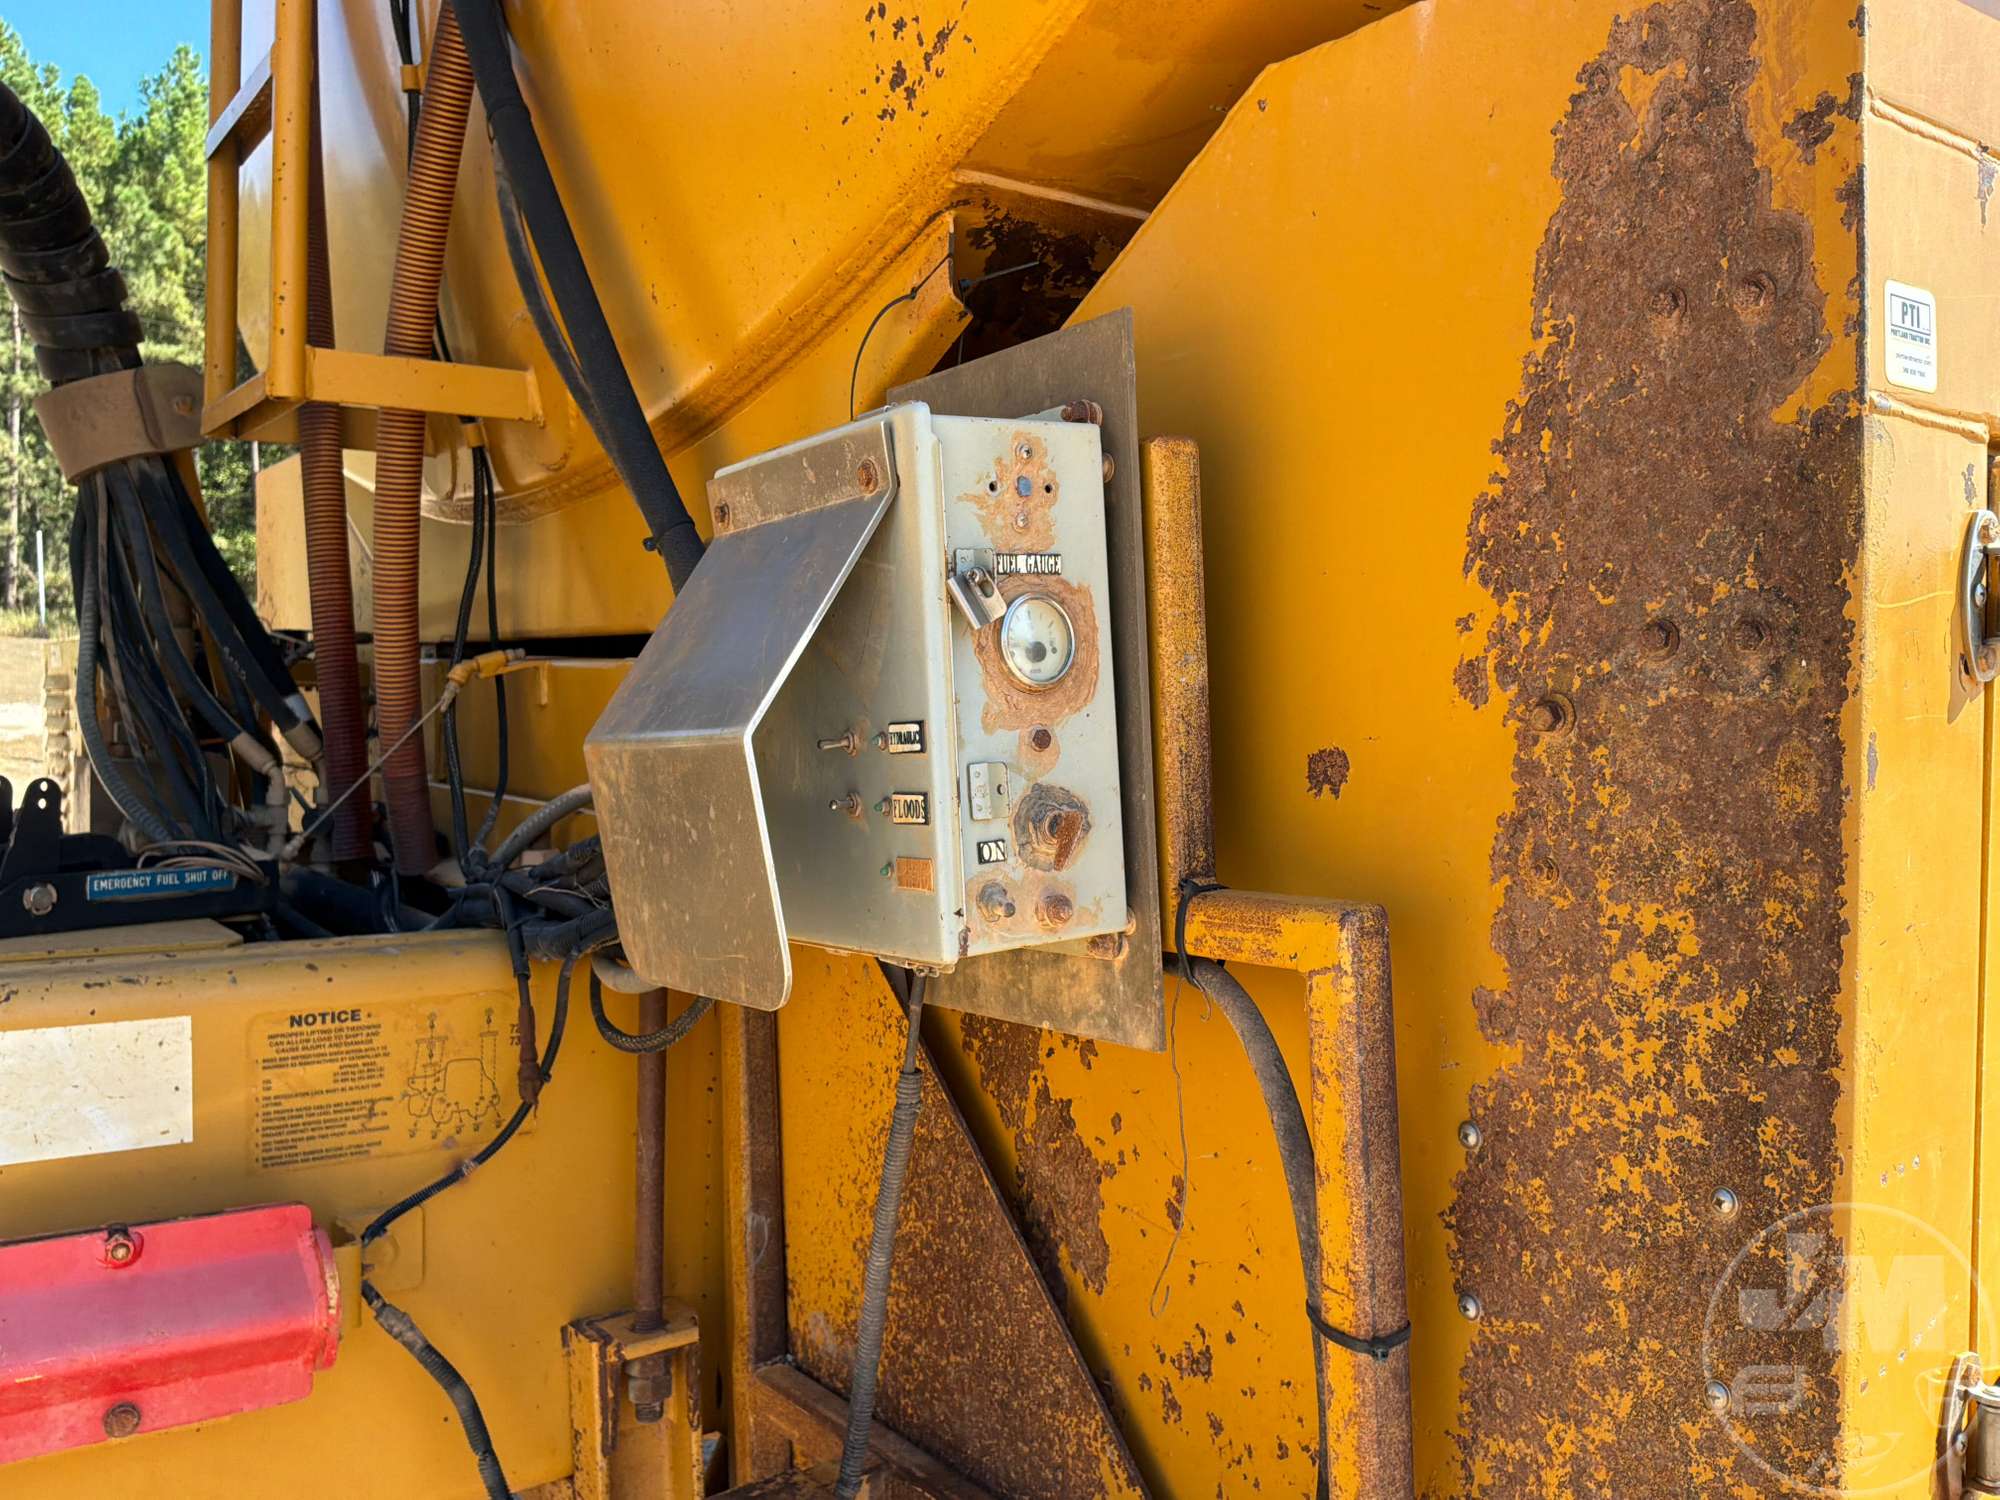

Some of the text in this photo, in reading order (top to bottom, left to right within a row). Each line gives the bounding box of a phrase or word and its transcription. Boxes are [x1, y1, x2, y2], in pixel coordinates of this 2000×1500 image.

[1901, 301, 1921, 328] PTI
[996, 554, 1061, 574] FUEL GAUGE
[893, 799, 925, 818] FLOODS
[981, 840, 1006, 862] ON
[93, 876, 151, 891] EMERGENCY
[156, 874, 180, 886] FUEL
[185, 870, 207, 884] SHUT
[289, 1009, 361, 1027] NOTICE
